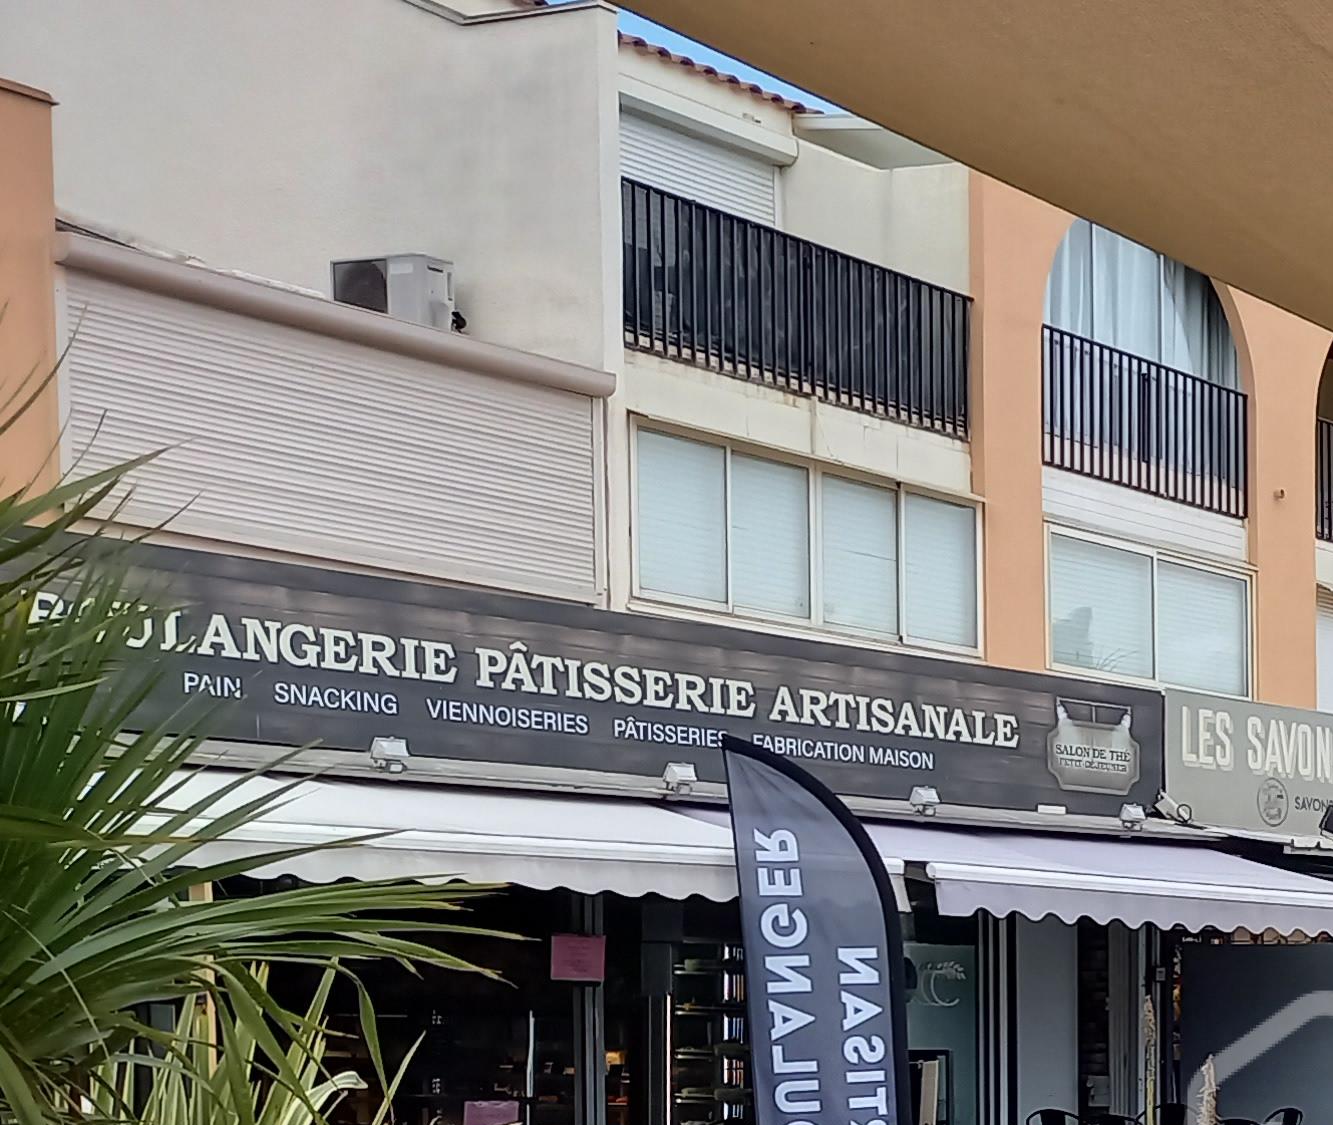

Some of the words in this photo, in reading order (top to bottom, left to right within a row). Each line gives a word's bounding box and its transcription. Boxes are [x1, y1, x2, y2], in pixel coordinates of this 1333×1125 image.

[184, 672, 241, 698] PAIN
[274, 682, 399, 714] SNACKING
[426, 699, 589, 734] VIENNOISERIES
[614, 716, 728, 748] PÂTISSERIES
[753, 734, 865, 763] FABRICATION
[869, 746, 934, 770] MAISON
[475, 641, 755, 719] PÂTISSERIE
[769, 686, 1019, 749] ARTISANALE
[1055, 744, 1089, 758] SALON
[1092, 748, 1106, 760] DE
[1109, 748, 1130, 763] THÉ
[1181, 705, 1234, 769] LES
[1294, 796, 1333, 812] SAVON
